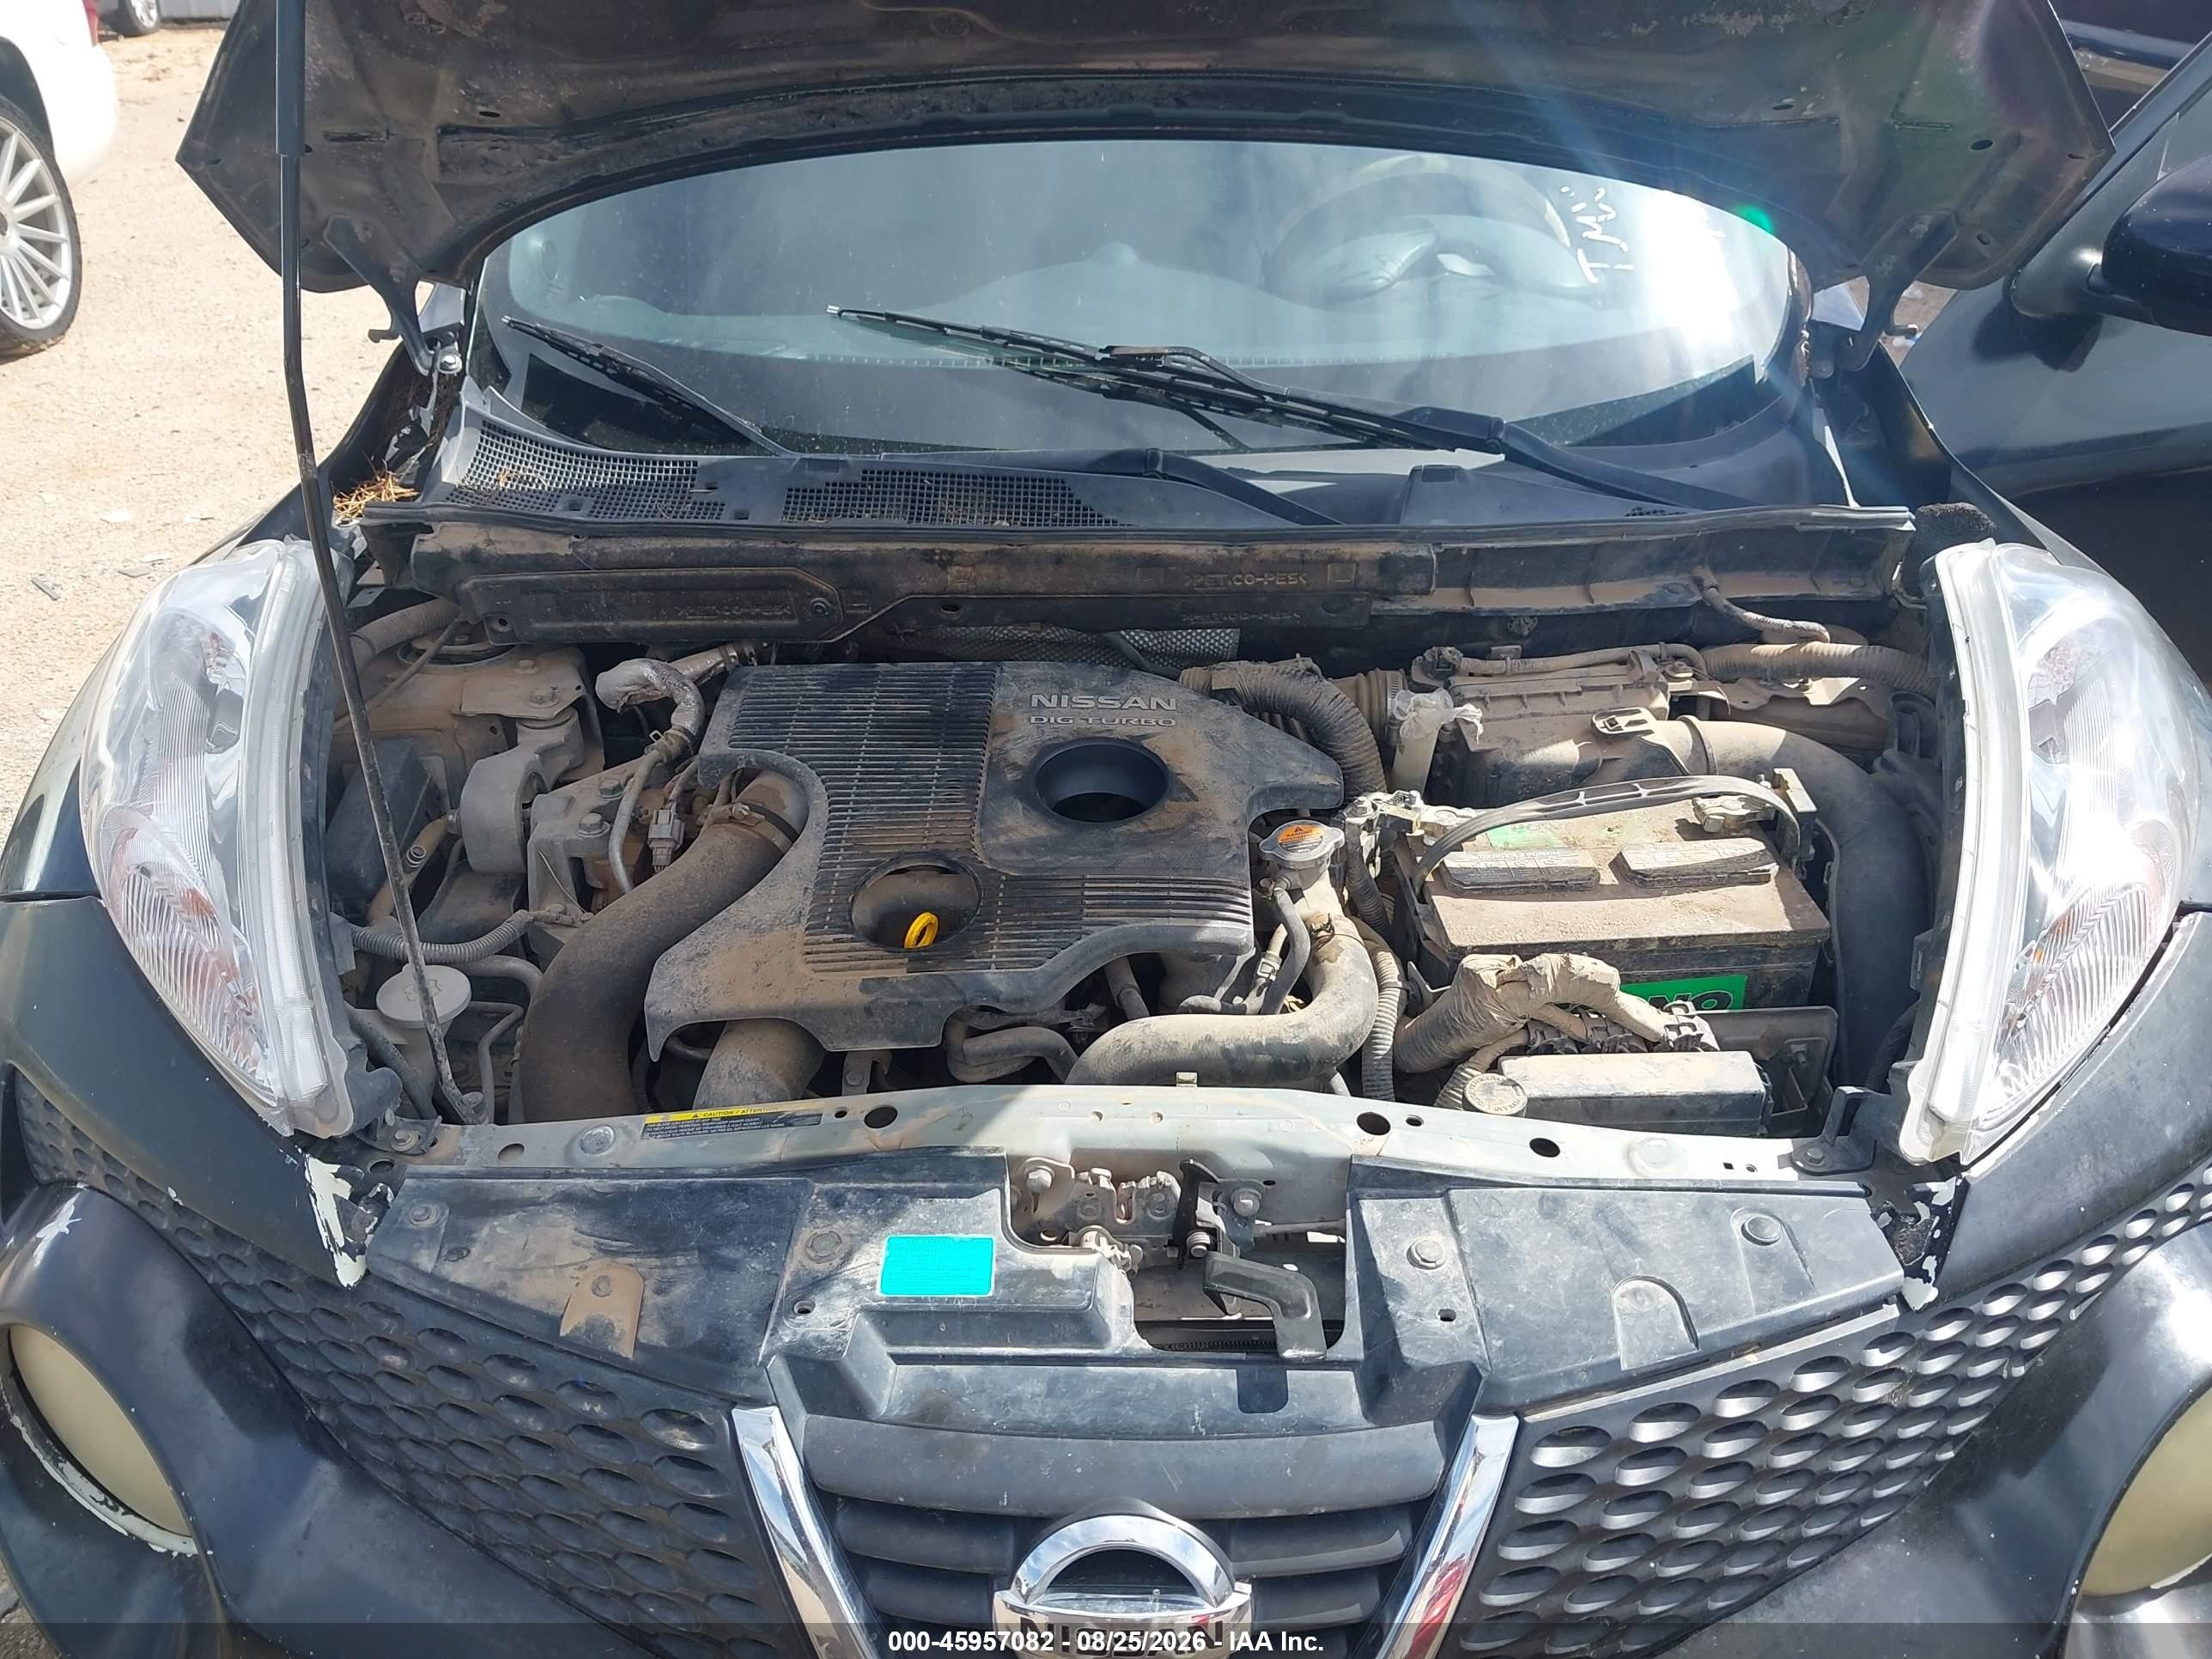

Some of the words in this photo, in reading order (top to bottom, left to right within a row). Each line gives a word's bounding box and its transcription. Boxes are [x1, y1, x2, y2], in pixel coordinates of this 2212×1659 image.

[1030, 693, 1177, 710] NISSAN
[1030, 715, 1073, 724] DIG
[1081, 715, 1177, 726] TURBO
